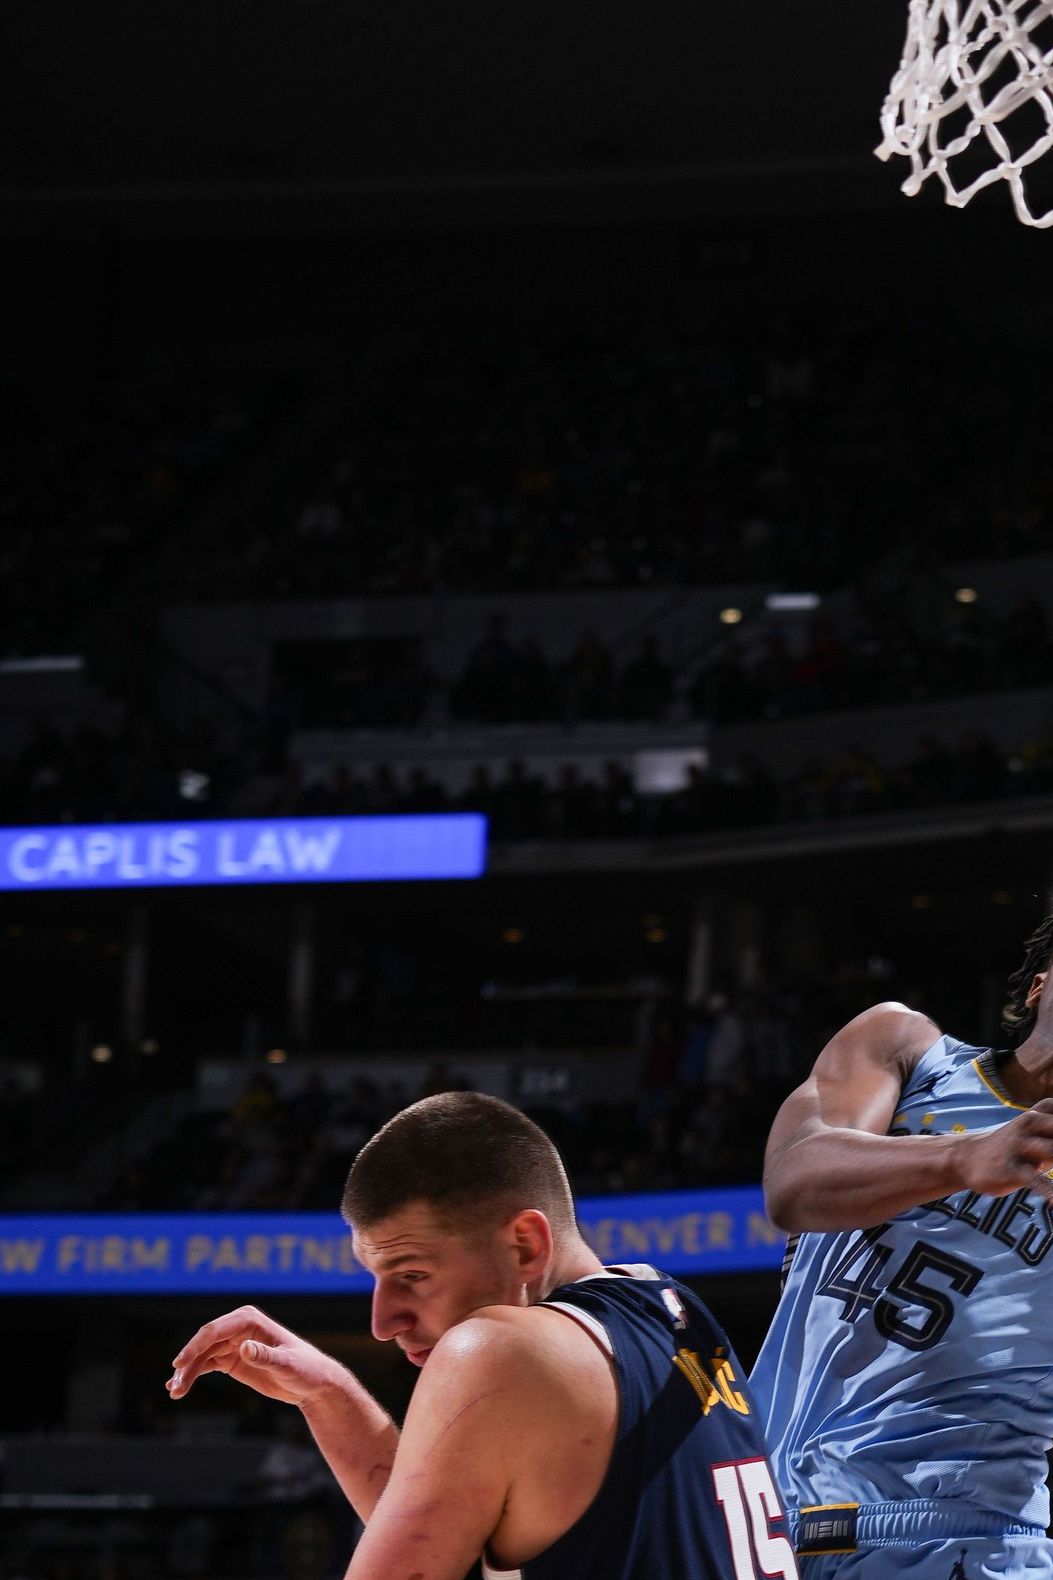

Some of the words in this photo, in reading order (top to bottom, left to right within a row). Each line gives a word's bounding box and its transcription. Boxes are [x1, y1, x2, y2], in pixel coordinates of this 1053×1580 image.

[8, 829, 199, 882] CAPLIS
[217, 827, 342, 878] LAW
[58, 1234, 172, 1275] FIRM
[184, 1233, 360, 1275] PARTNE
[814, 1222, 986, 1352] 45
